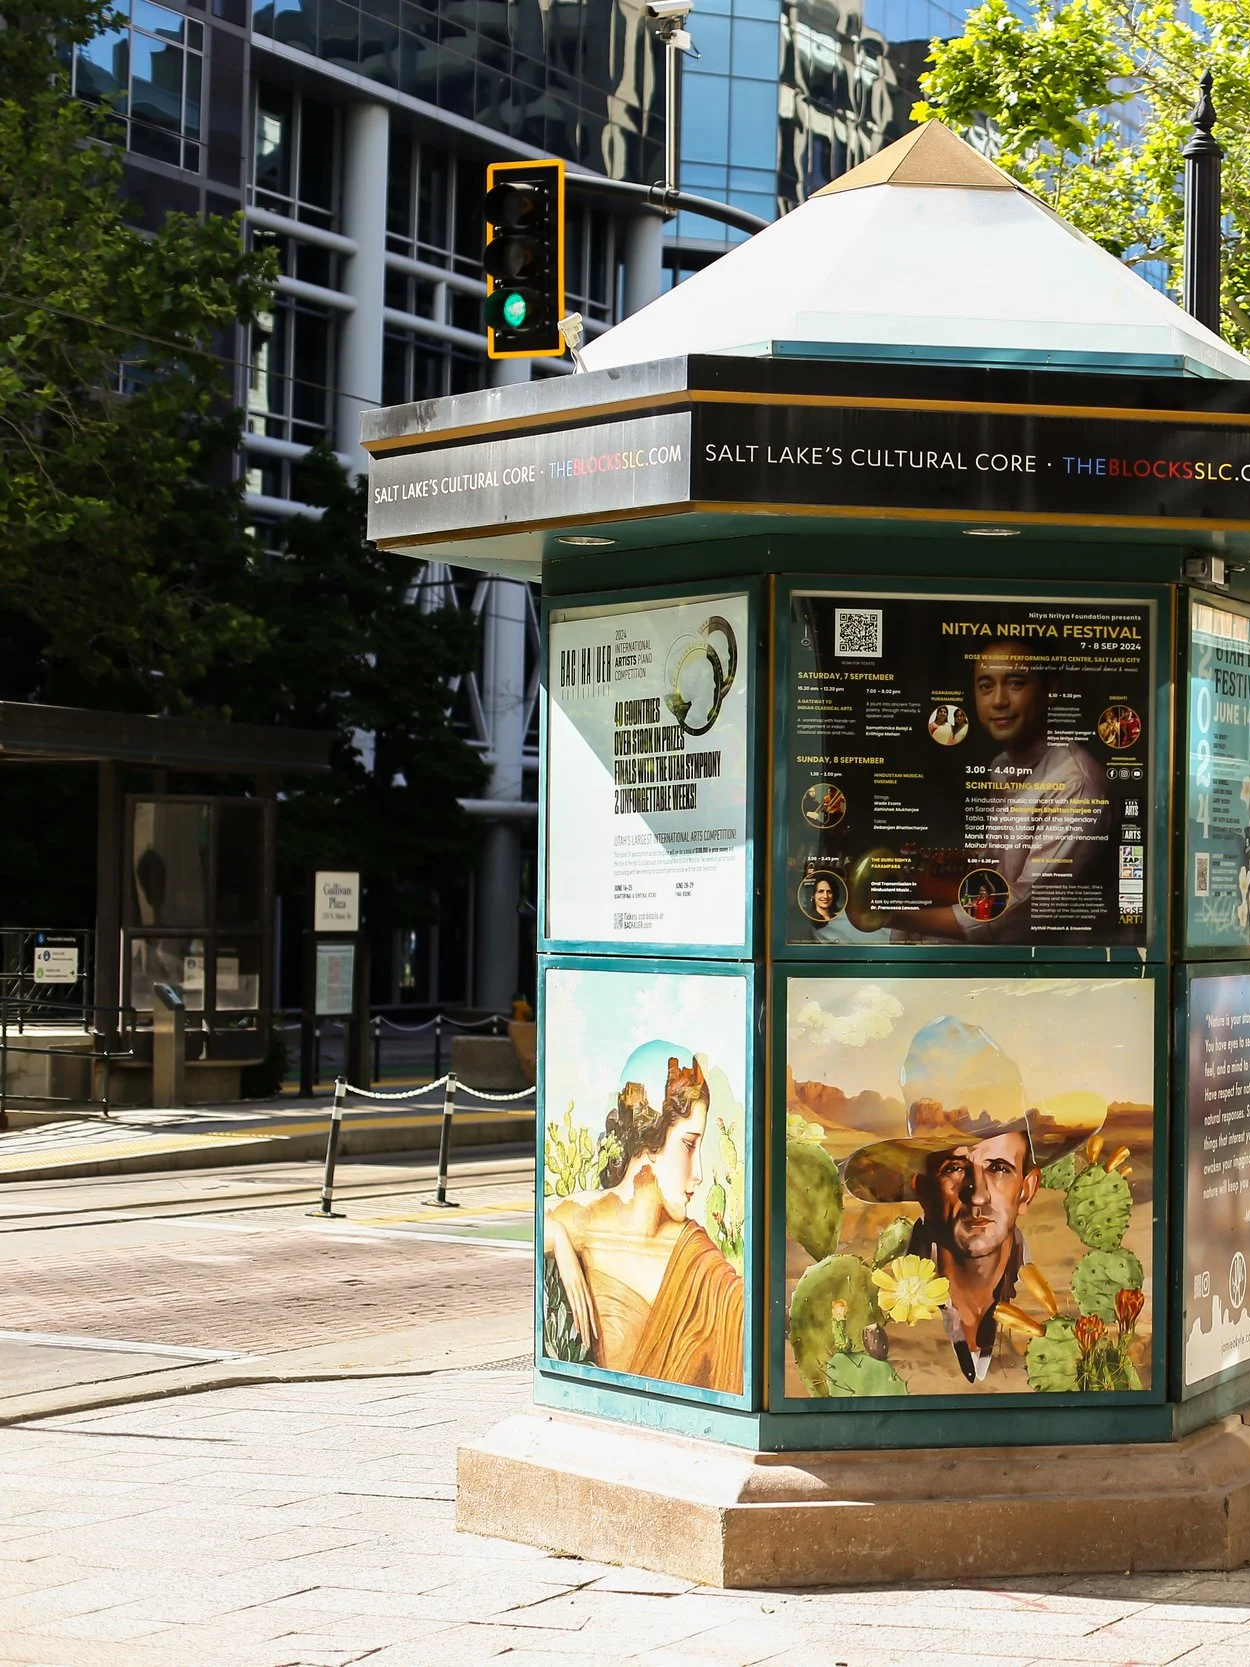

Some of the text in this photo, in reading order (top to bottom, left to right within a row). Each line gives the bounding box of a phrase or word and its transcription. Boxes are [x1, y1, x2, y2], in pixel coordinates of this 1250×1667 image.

[706, 444, 758, 462] SALT
[768, 446, 842, 465] LAKE'S
[851, 449, 967, 470] CULTURAL
[976, 454, 1036, 472] CORE
[374, 444, 681, 504] SALT LAKE'S CULTURAL CORE THEBLOCKSSLC.COM
[615, 629, 627, 641] 2024
[942, 622, 1141, 639] NITYA NRITYA FESTIVAL
[615, 639, 652, 654] INTERNATIONAL
[615, 653, 652, 666] ARTISTS PIANO
[614, 667, 646, 681] COMPETITION
[798, 672, 842, 680] SATURDAY,
[615, 698, 660, 727] 40 COUNTRIES
[1214, 701, 1239, 724] JUNE
[615, 725, 684, 756] OVER $100K IN PRIZES
[615, 751, 721, 785] FINALS WITH THE UTAH SYMPHONY
[797, 756, 832, 764] SUNDAY,
[966, 766, 1032, 776] 3.00 4.40 pm
[965, 782, 1065, 790] SCINTILLATING SAROD
[615, 783, 697, 814] 2 UNFORGETTABLE WEEKS!
[1125, 805, 1138, 816] ARTS
[999, 816, 1029, 824] youngest
[691, 830, 703, 842] ARTS
[704, 829, 736, 842] COMPETITION!
[1125, 830, 1141, 840] ARTS
[323, 883, 351, 895] Gallivan
[329, 897, 346, 909] Plaza
[1226, 1013, 1230, 1026] is
[1231, 1015, 1241, 1029] your
[1205, 1039, 1214, 1052] You
[1215, 1037, 1226, 1051] have
[1228, 1039, 1238, 1053] eyes
[1239, 1036, 1244, 1048] to
[1205, 1061, 1215, 1078] feel,
[1217, 1060, 1226, 1075] and
[1231, 1057, 1242, 1073] mind
[1244, 1060, 1248, 1071] to
[1205, 1088, 1217, 1101] Have
[1218, 1085, 1235, 1102] respect
[1204, 1108, 1221, 1126] natural
[1221, 1109, 1245, 1125] responses.
[1204, 1135, 1217, 1153] things
[1219, 1132, 1228, 1147] that
[1228, 1130, 1245, 1145] interest
[1204, 1158, 1221, 1175] awaken
[1222, 1159, 1233, 1174] your
[1203, 1179, 1249, 1200] nature will keep you
